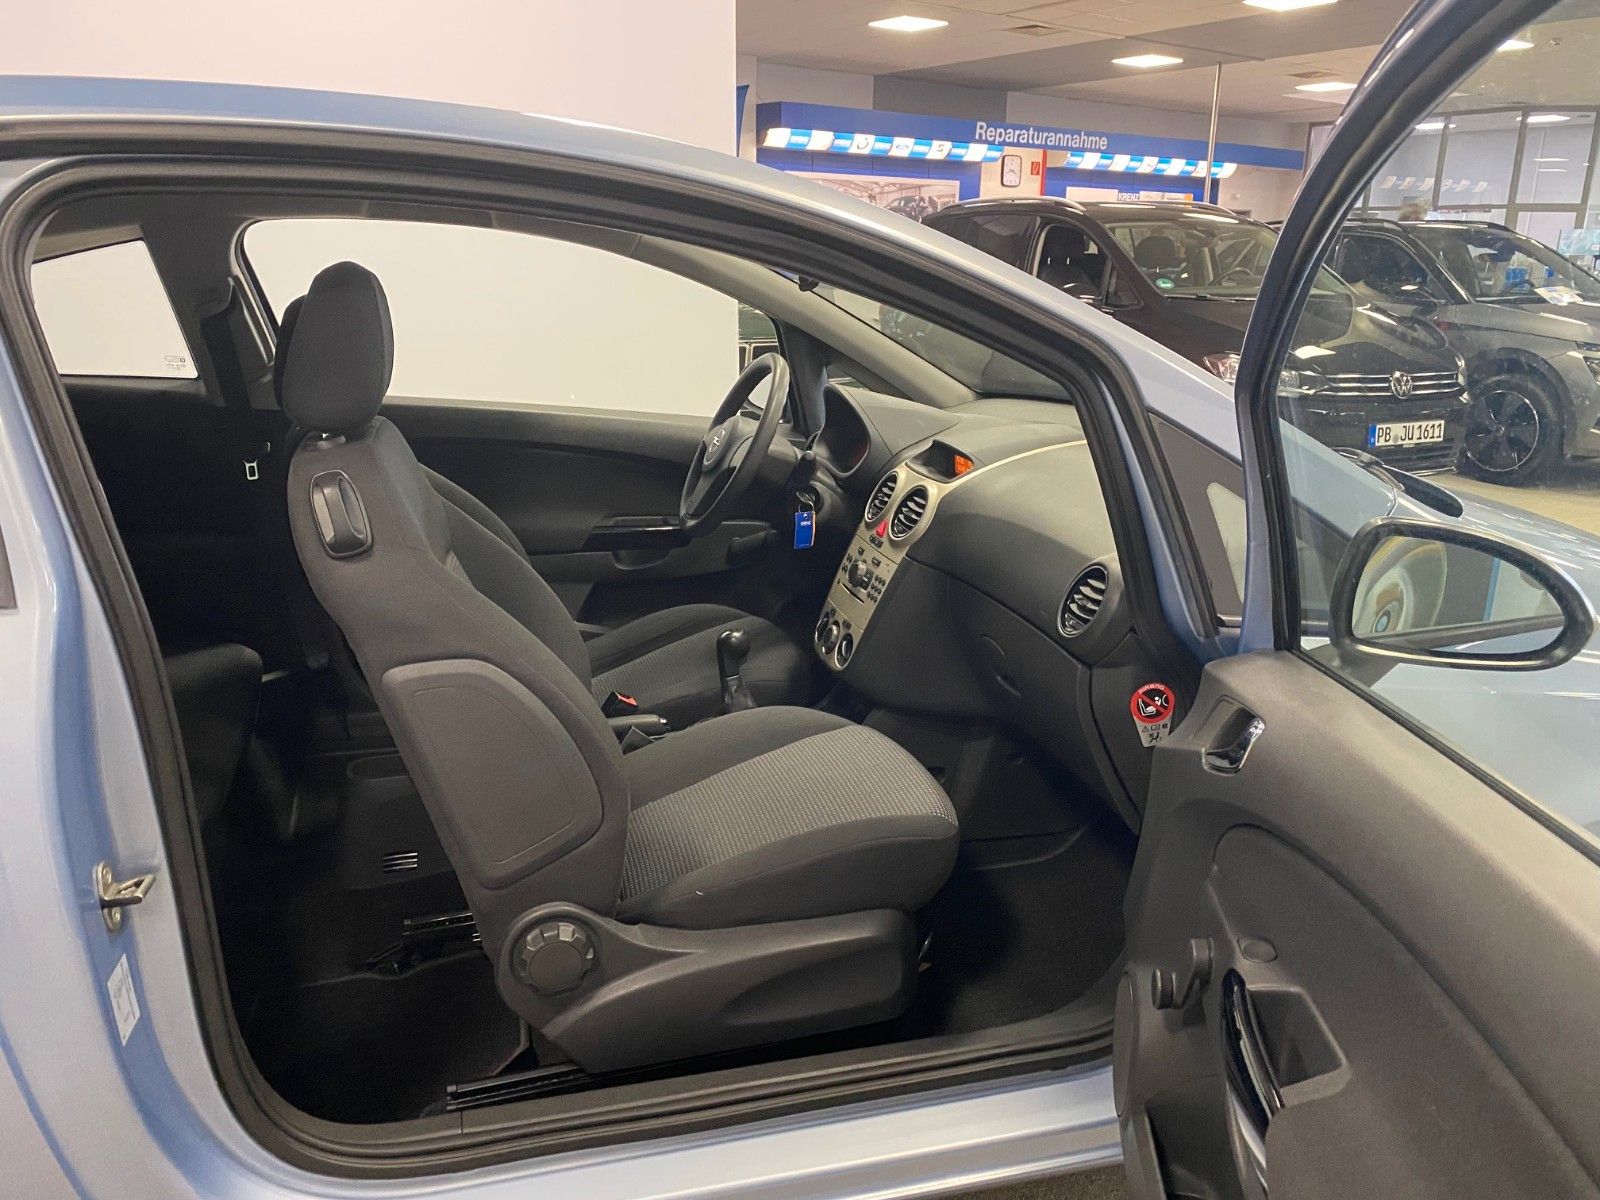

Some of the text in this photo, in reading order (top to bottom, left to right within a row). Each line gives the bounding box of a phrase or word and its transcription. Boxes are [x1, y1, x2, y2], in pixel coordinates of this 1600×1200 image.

[975, 121, 1108, 150] Reparaturannahme
[1377, 423, 1442, 444] PB JU 1611
